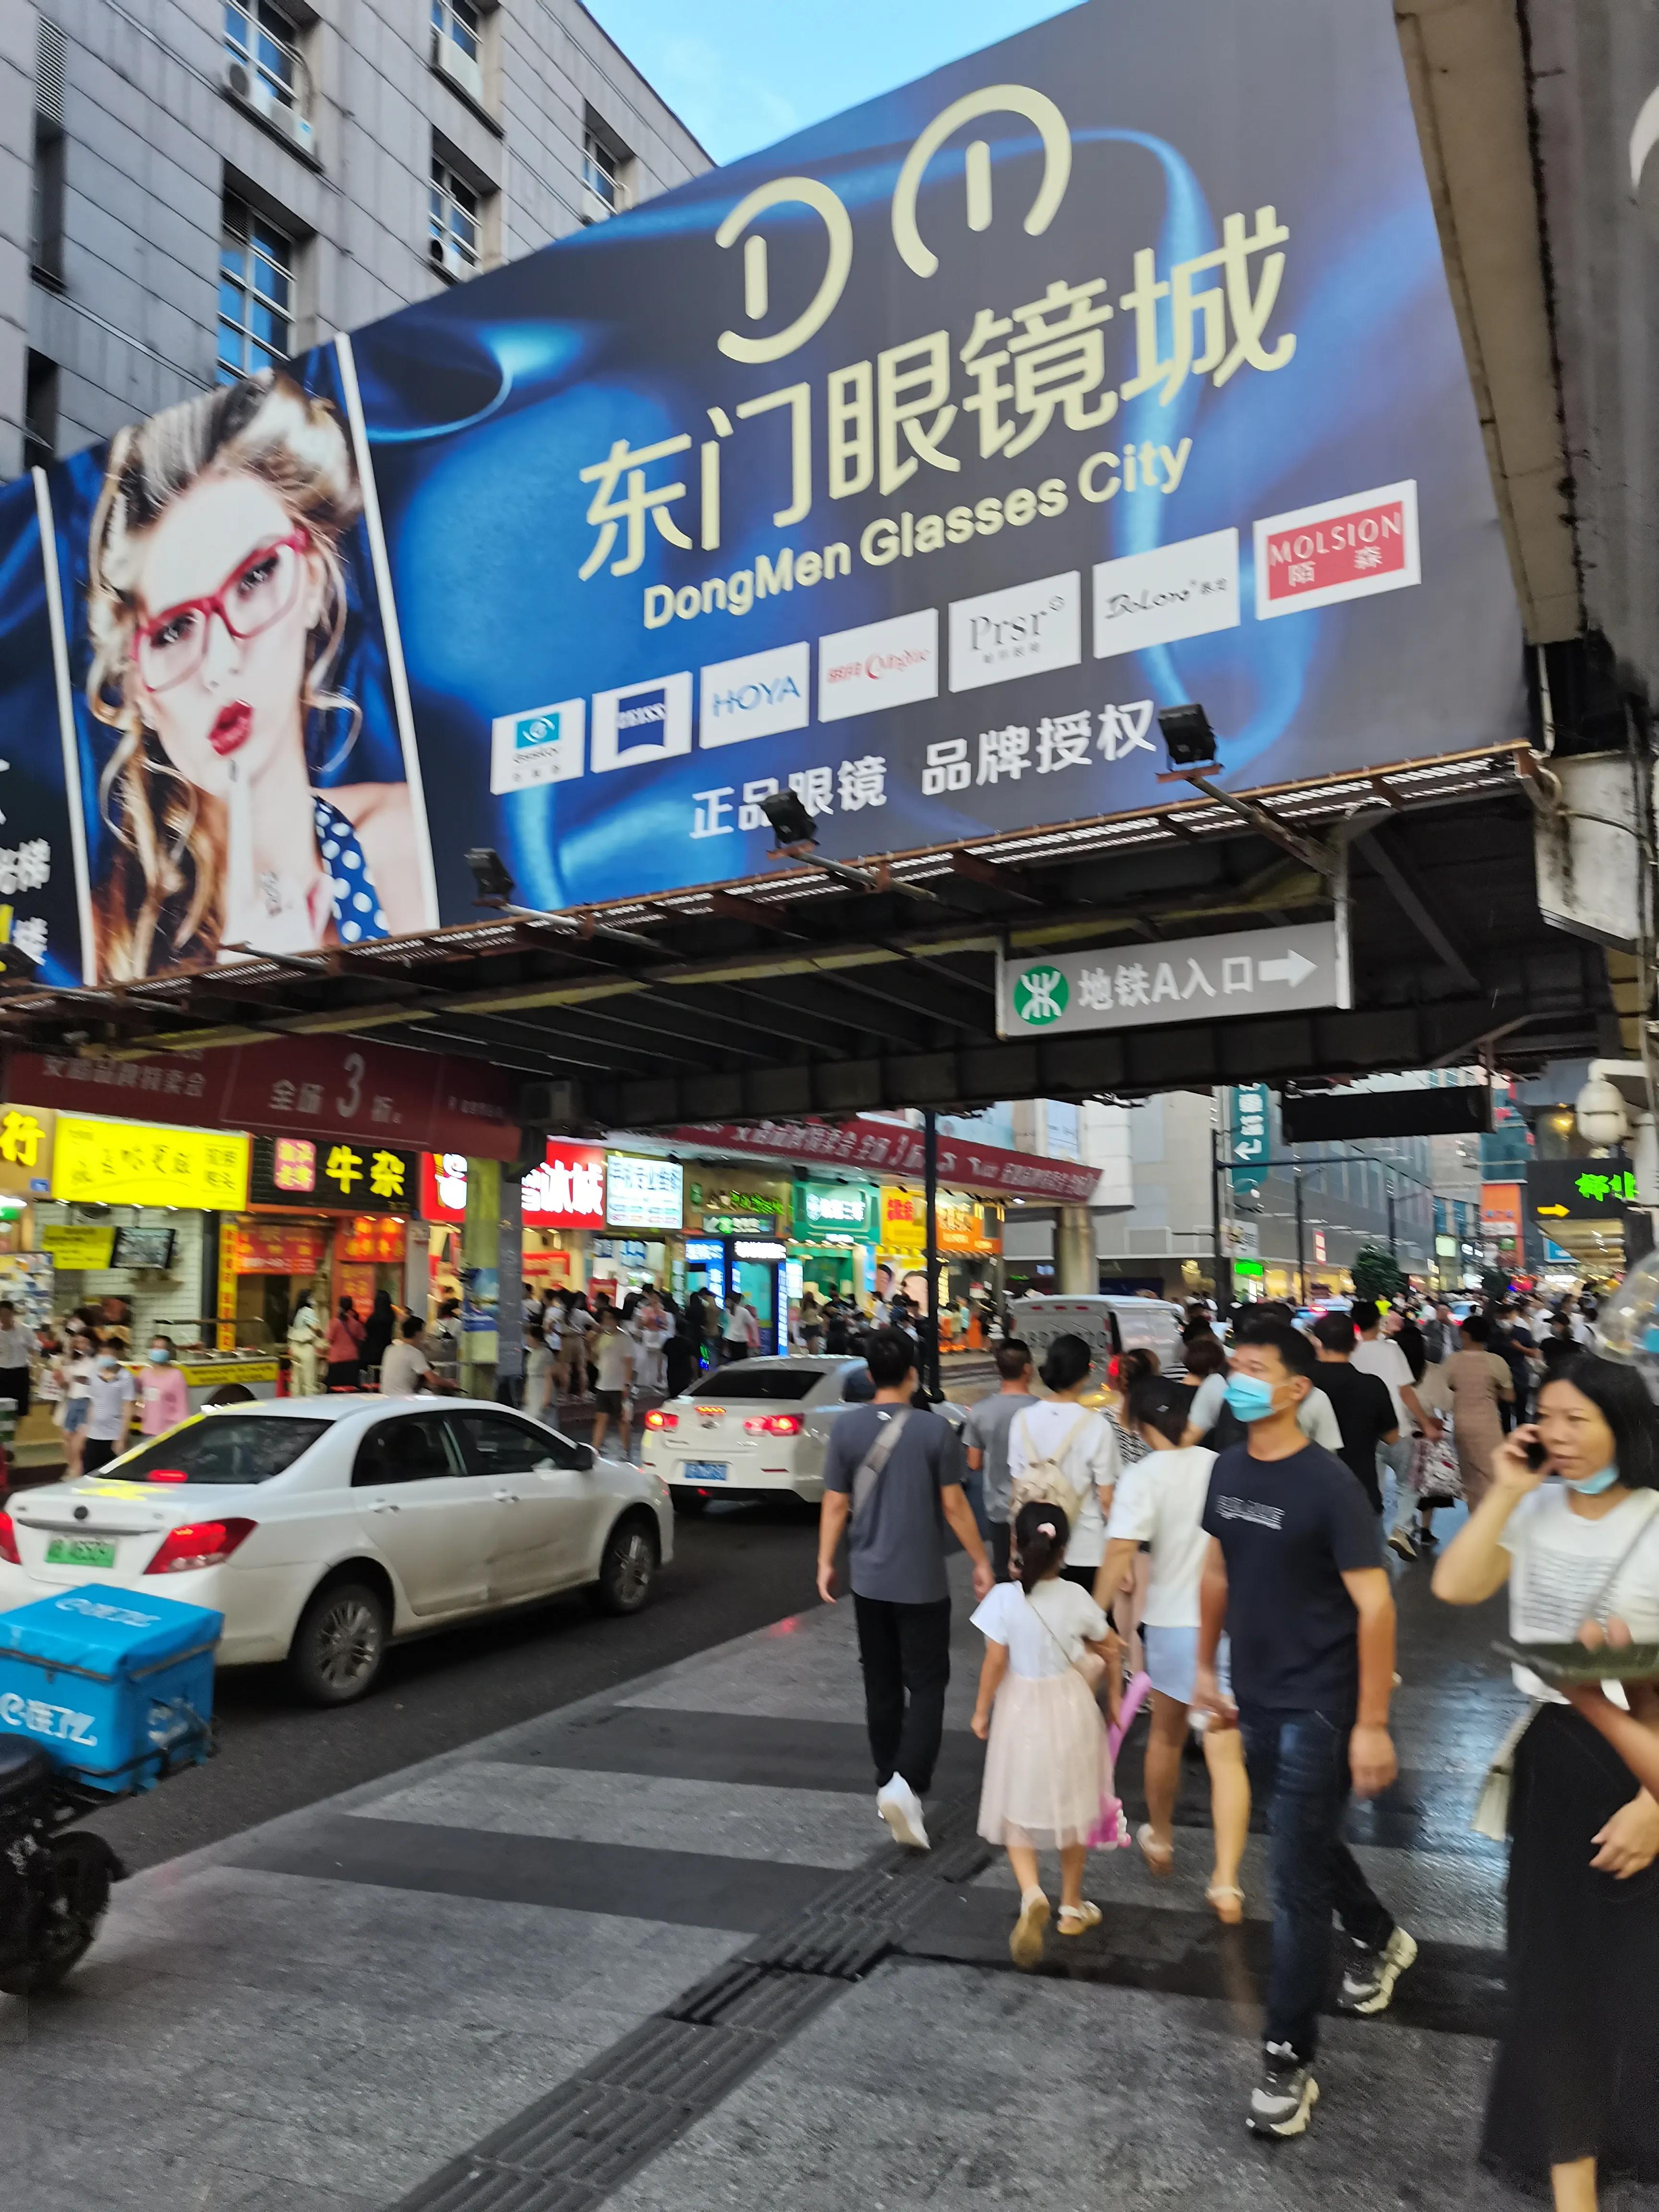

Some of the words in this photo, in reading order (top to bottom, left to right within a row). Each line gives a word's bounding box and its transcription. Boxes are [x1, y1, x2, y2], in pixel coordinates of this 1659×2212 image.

[577, 204, 1297, 582] 东门眼镜城
[644, 541, 851, 630] DongMen
[860, 478, 1069, 566] Glasses
[1078, 436, 1193, 503] City
[1269, 511, 1403, 566] MOLSION
[712, 675, 801, 717] HOYA
[689, 755, 888, 839] 正品眼镜
[922, 699, 1157, 796] 品牌授权
[1077, 955, 1254, 1011] 地铁A入口
[325, 1144, 405, 1198] 牛杂
